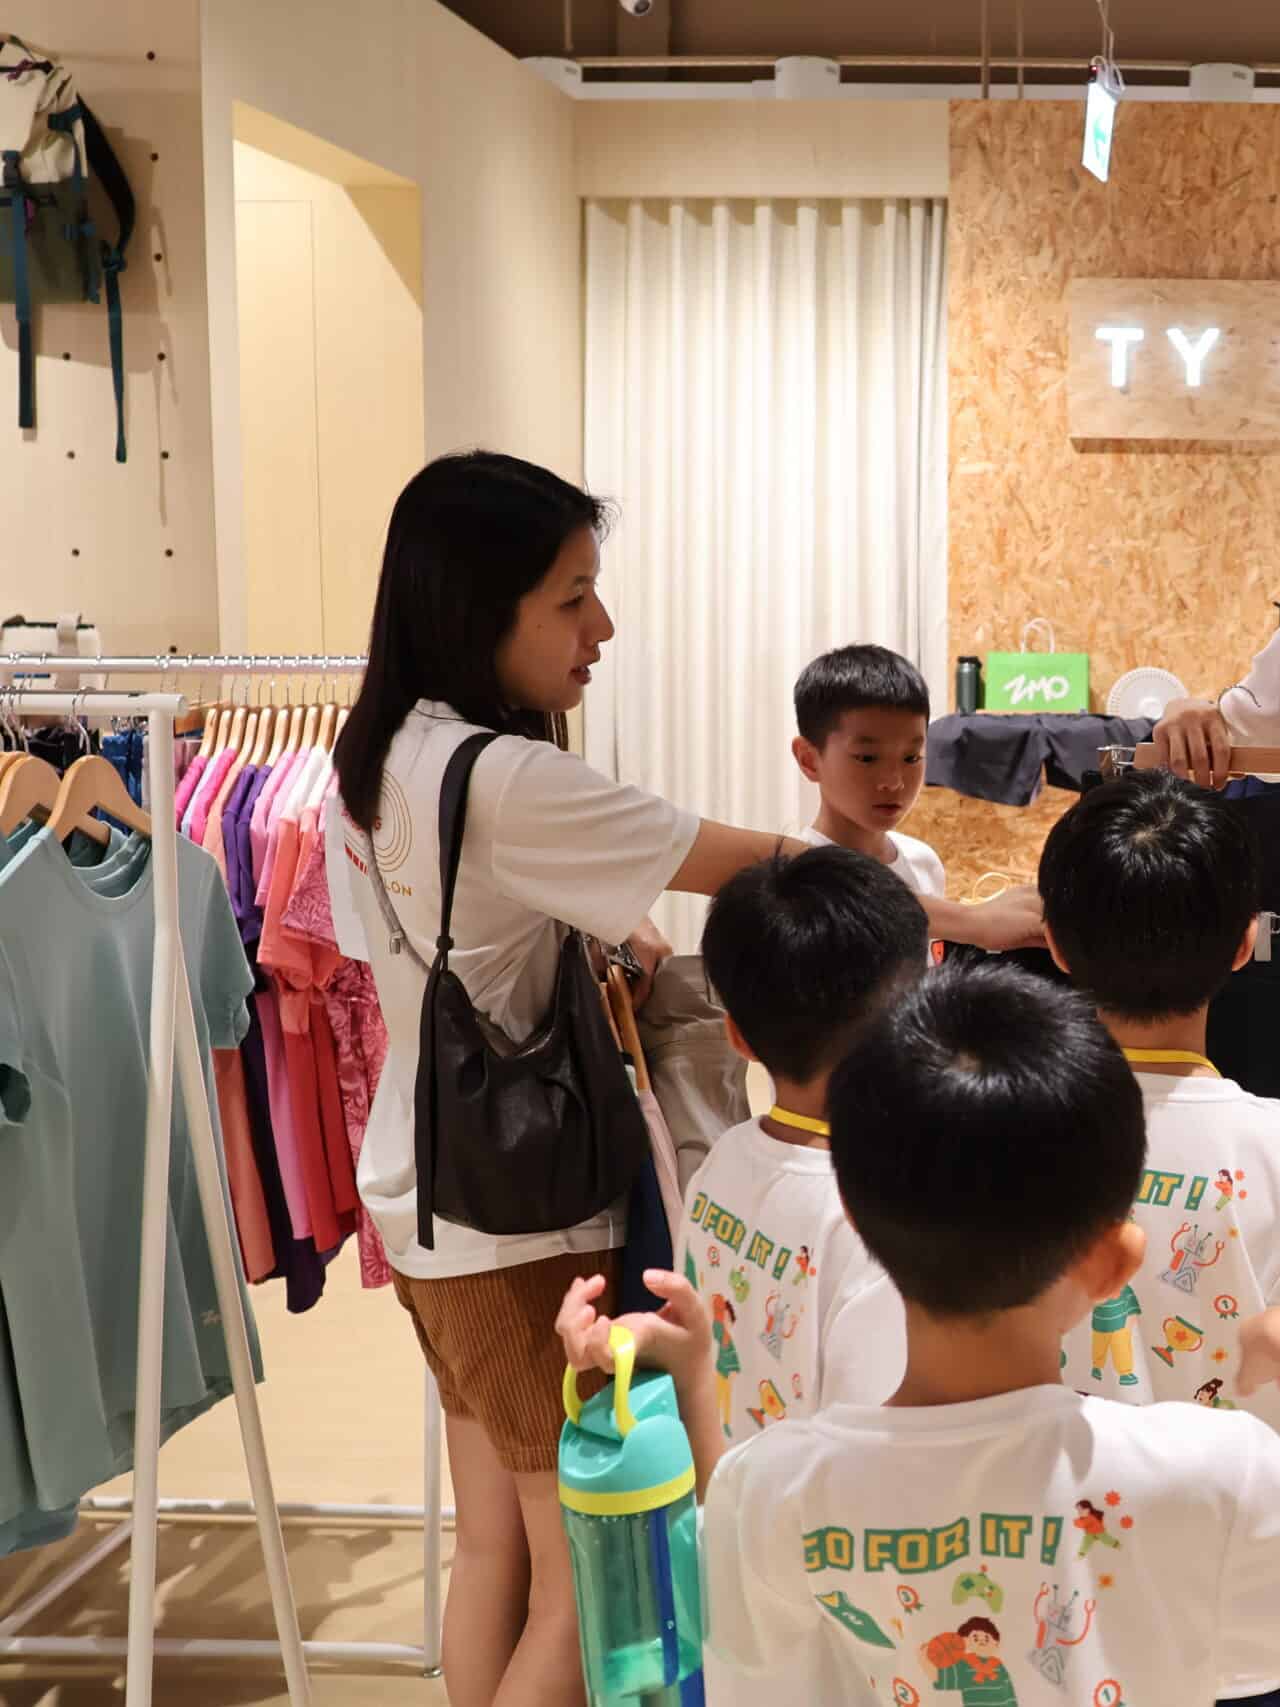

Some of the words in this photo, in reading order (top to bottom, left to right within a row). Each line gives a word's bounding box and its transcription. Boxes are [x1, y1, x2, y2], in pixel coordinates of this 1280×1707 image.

[1095, 326, 1221, 388] TY
[802, 1526, 854, 1572] GO
[864, 1517, 970, 1574] FOR
